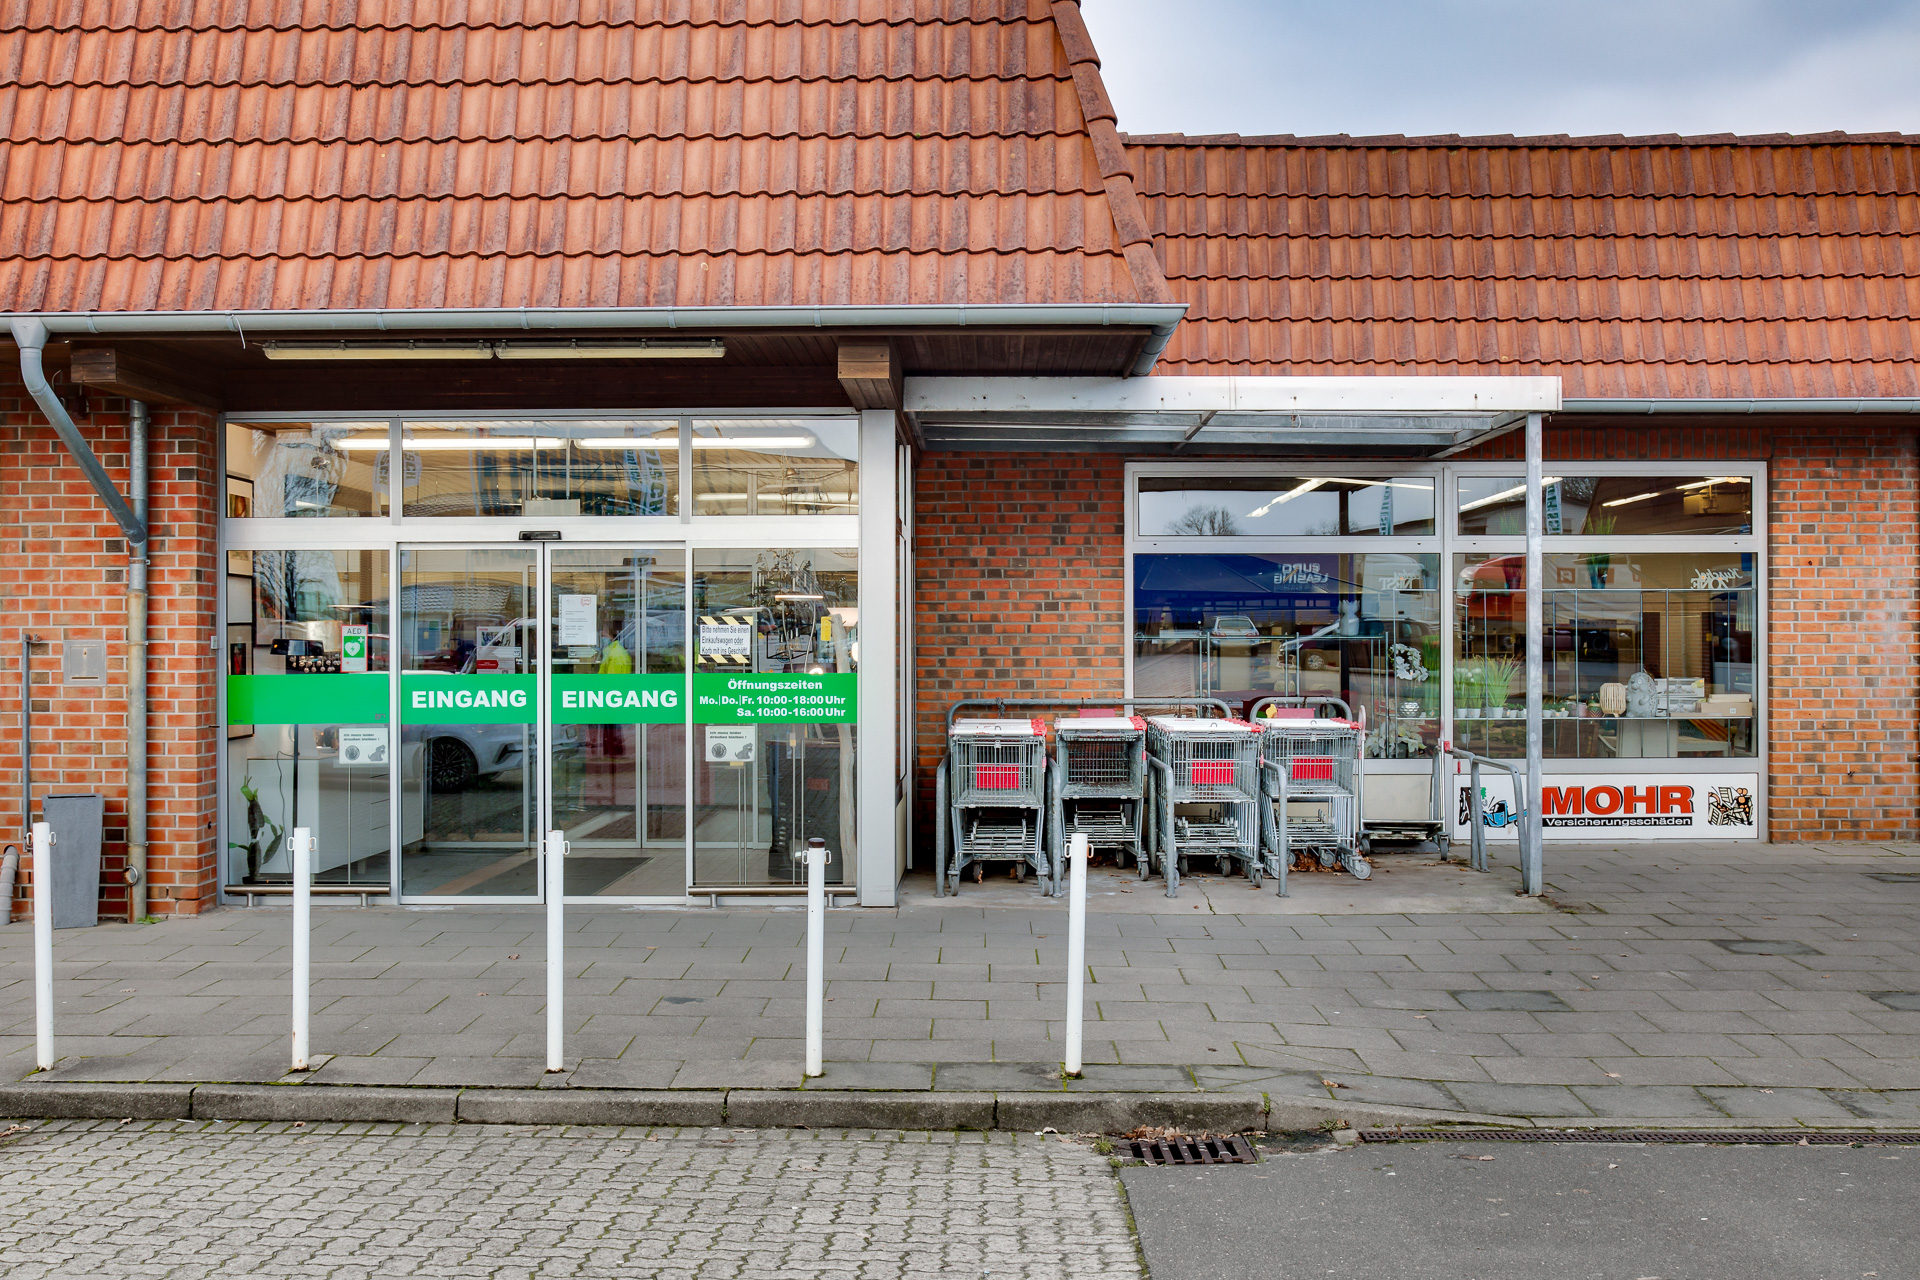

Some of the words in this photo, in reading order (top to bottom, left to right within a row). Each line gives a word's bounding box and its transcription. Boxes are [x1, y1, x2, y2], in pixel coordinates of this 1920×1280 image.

[702, 626, 712, 634] Bitte
[712, 626, 730, 634] nehmen
[738, 626, 750, 634] einen
[702, 636, 734, 646] Einkaufswagen
[734, 636, 744, 645] oder
[702, 646, 712, 654] Korb
[728, 646, 748, 654] Geschäft!
[728, 678, 823, 692] Öffnungszeiten
[412, 690, 527, 708] EINGANG
[562, 690, 678, 708] EINGANG
[825, 696, 846, 704] Uhr
[736, 708, 754, 716] Sa.
[825, 708, 846, 716] Uhr
[1542, 785, 1695, 815] MOHR
[1546, 816, 1692, 827] Versicherungsschäden
